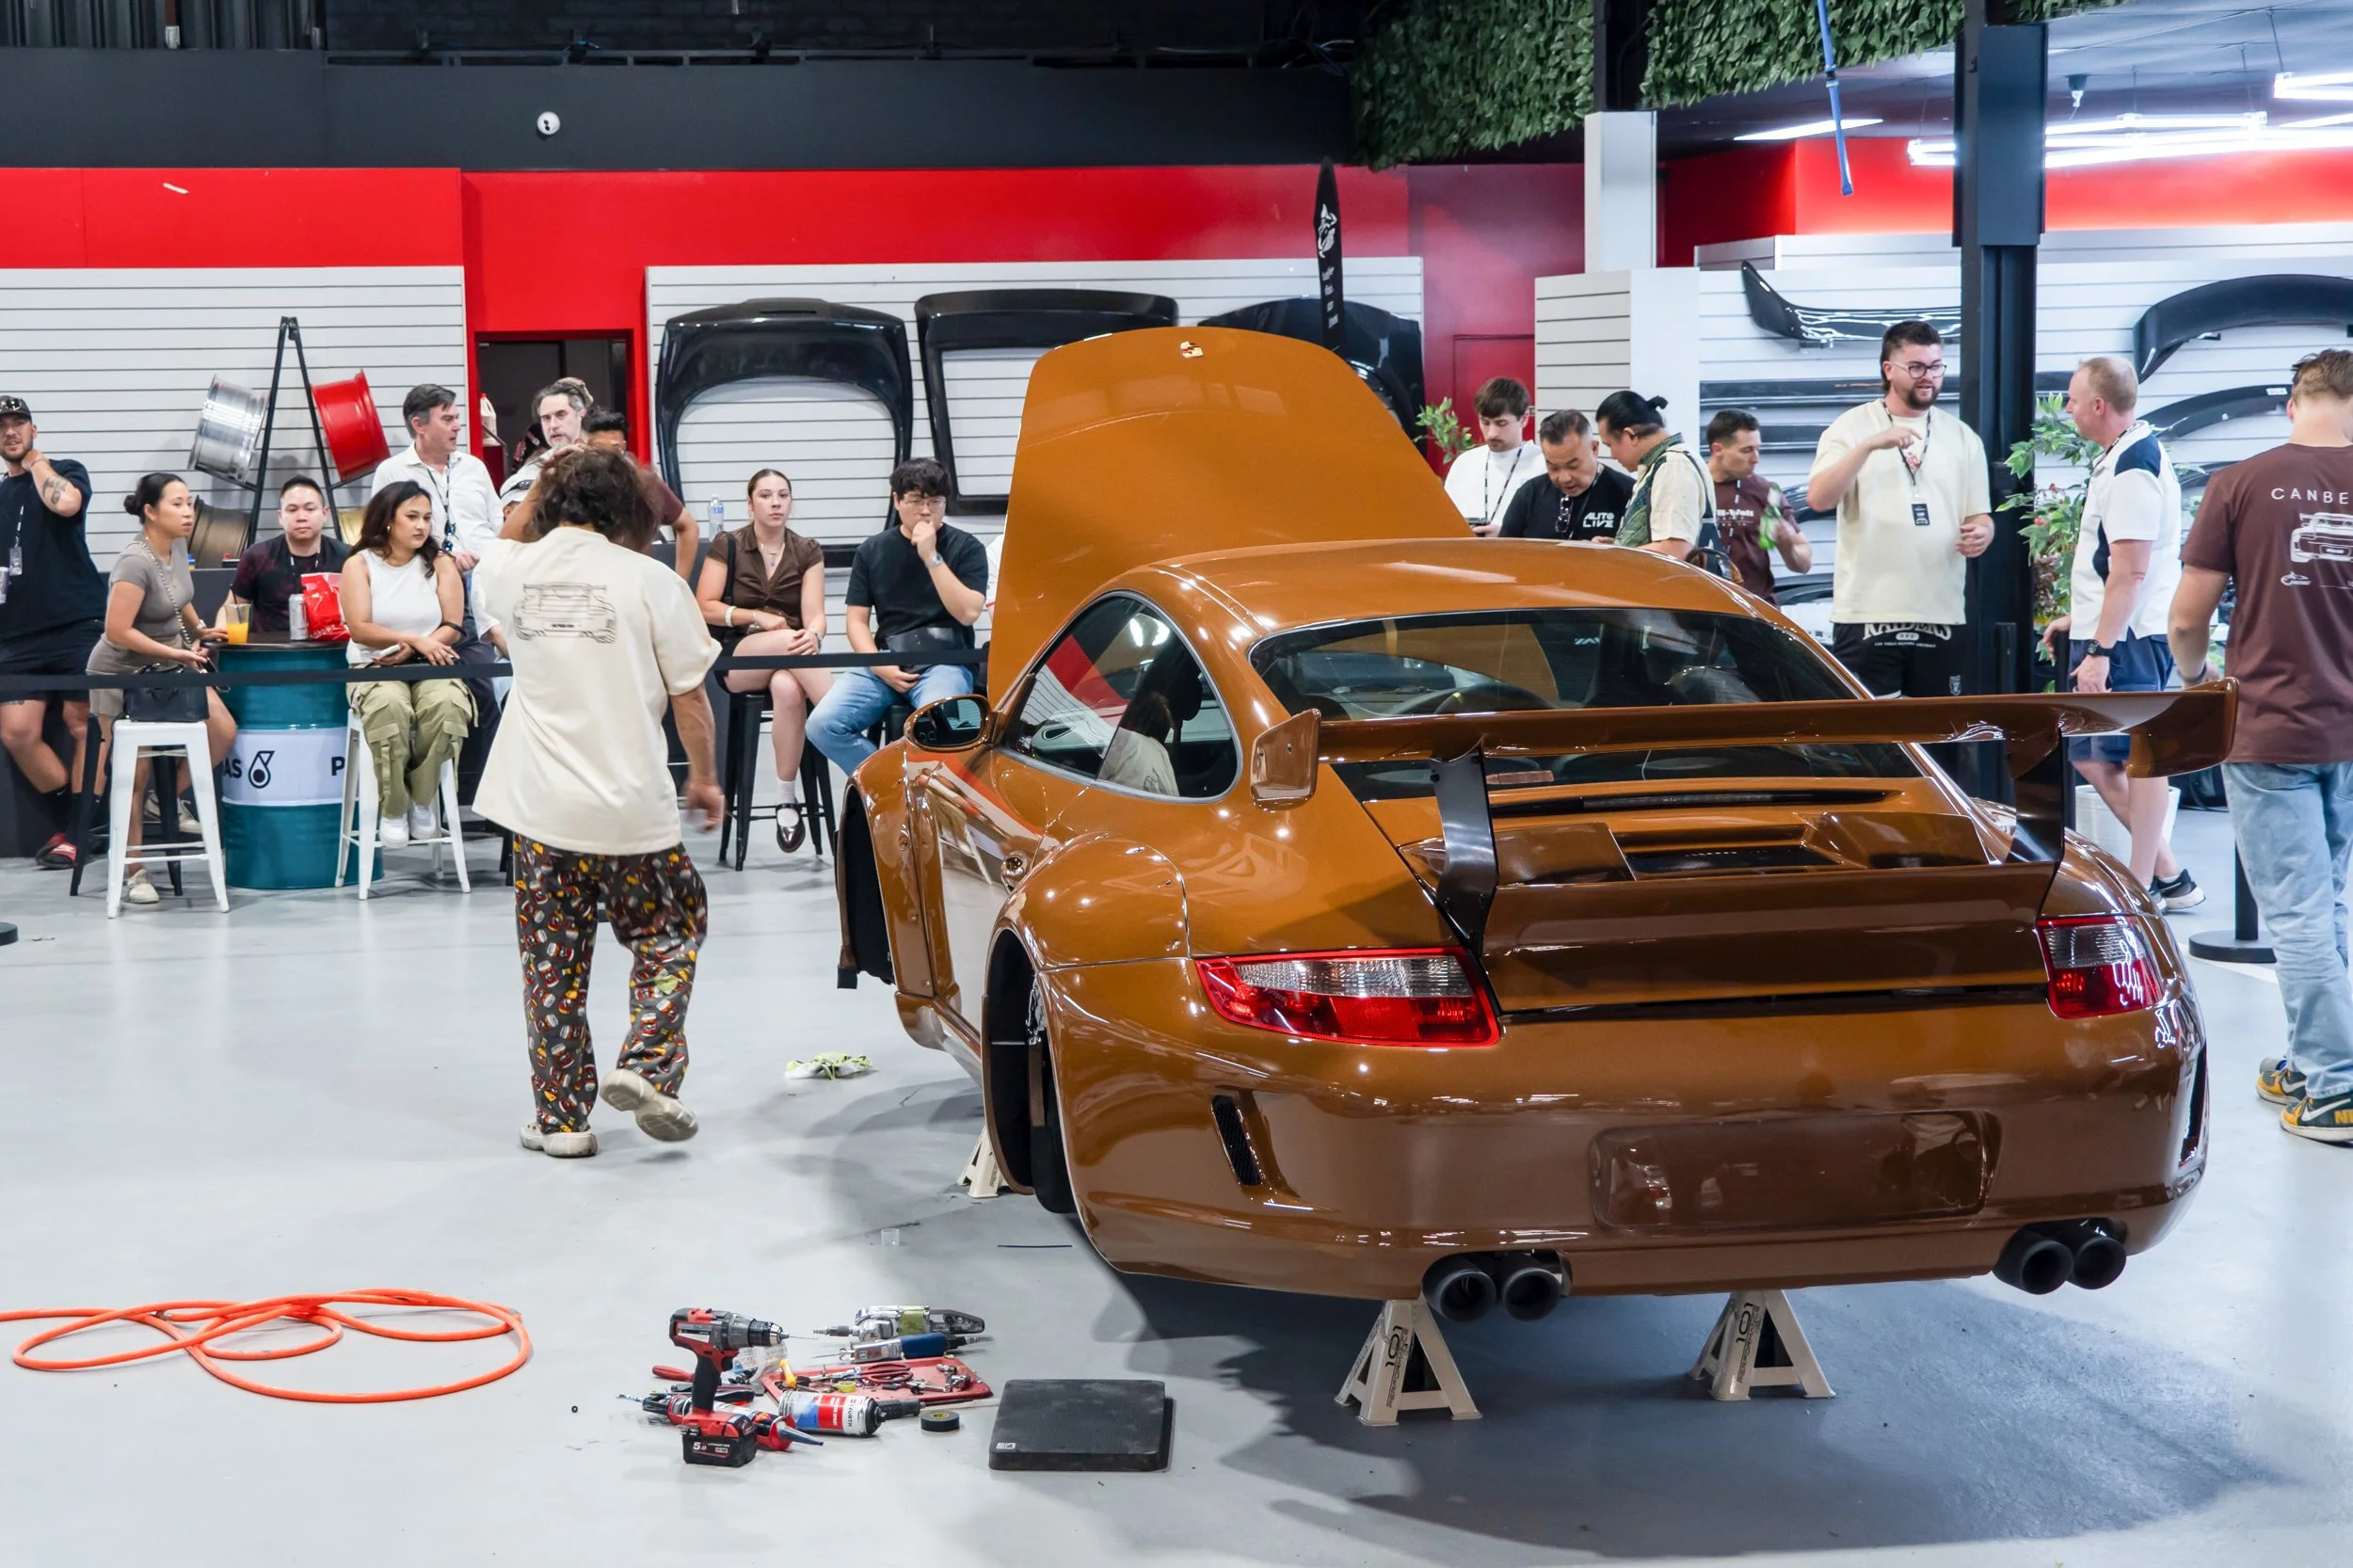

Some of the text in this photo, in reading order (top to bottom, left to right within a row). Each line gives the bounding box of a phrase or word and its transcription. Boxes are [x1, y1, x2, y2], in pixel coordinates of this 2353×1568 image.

[2270, 488, 2349, 504] CANBE
[1584, 512, 1615, 520] AUTO
[1736, 1303, 1753, 1343] 101
[1385, 1325, 1402, 1368] 101
